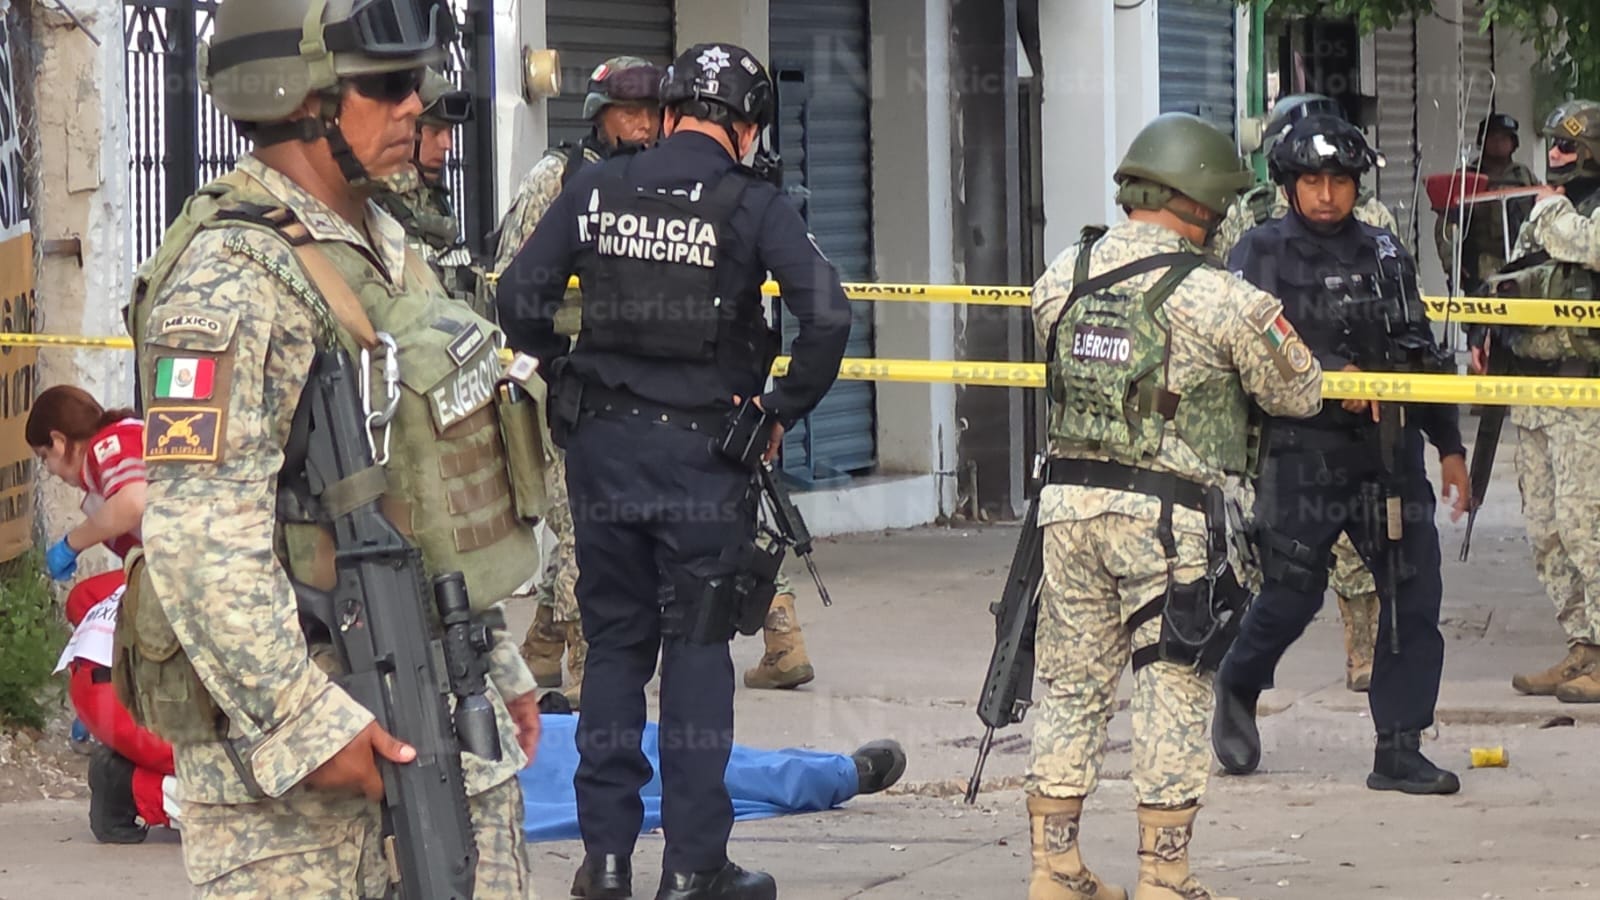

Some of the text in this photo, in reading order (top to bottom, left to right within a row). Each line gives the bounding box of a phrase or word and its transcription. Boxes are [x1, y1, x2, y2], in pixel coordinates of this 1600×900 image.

[600, 211, 717, 246] POLICÍA
[598, 234, 715, 267] MUNICIPAL
[164, 314, 219, 332] MÉXICO
[1073, 329, 1130, 361] EJÉRCITO
